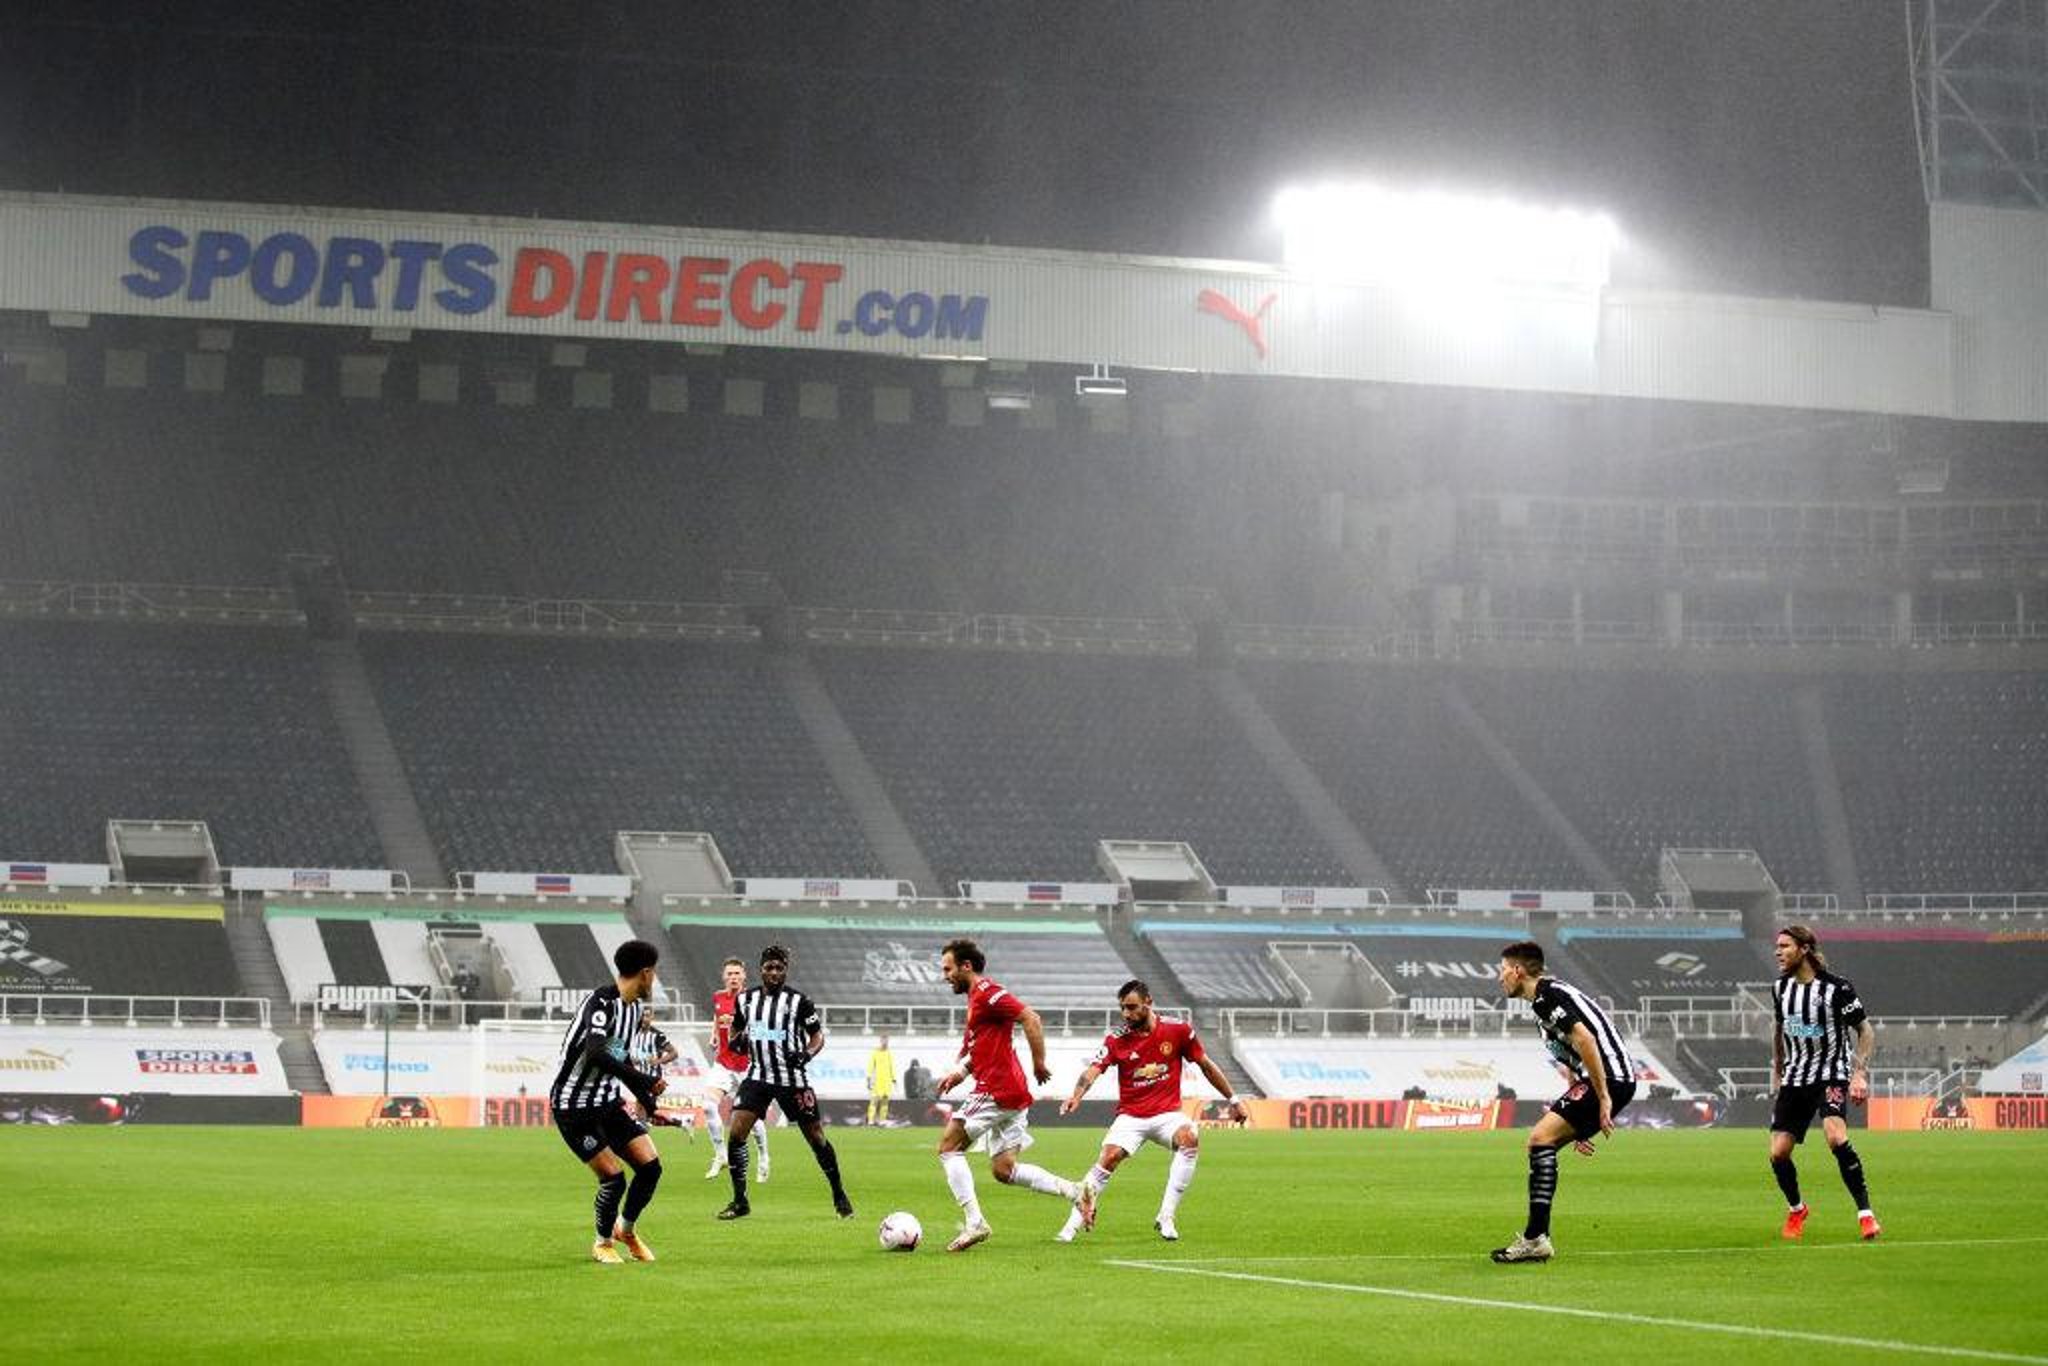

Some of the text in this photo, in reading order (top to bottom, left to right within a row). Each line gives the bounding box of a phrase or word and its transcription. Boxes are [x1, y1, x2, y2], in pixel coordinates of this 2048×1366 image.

[1395, 960, 1502, 979] #NU
[322, 984, 397, 1011] PUMA
[1410, 997, 1474, 1020] PUMA
[143, 1050, 247, 1061] SPORTS
[146, 1062, 252, 1074] DIRECT
